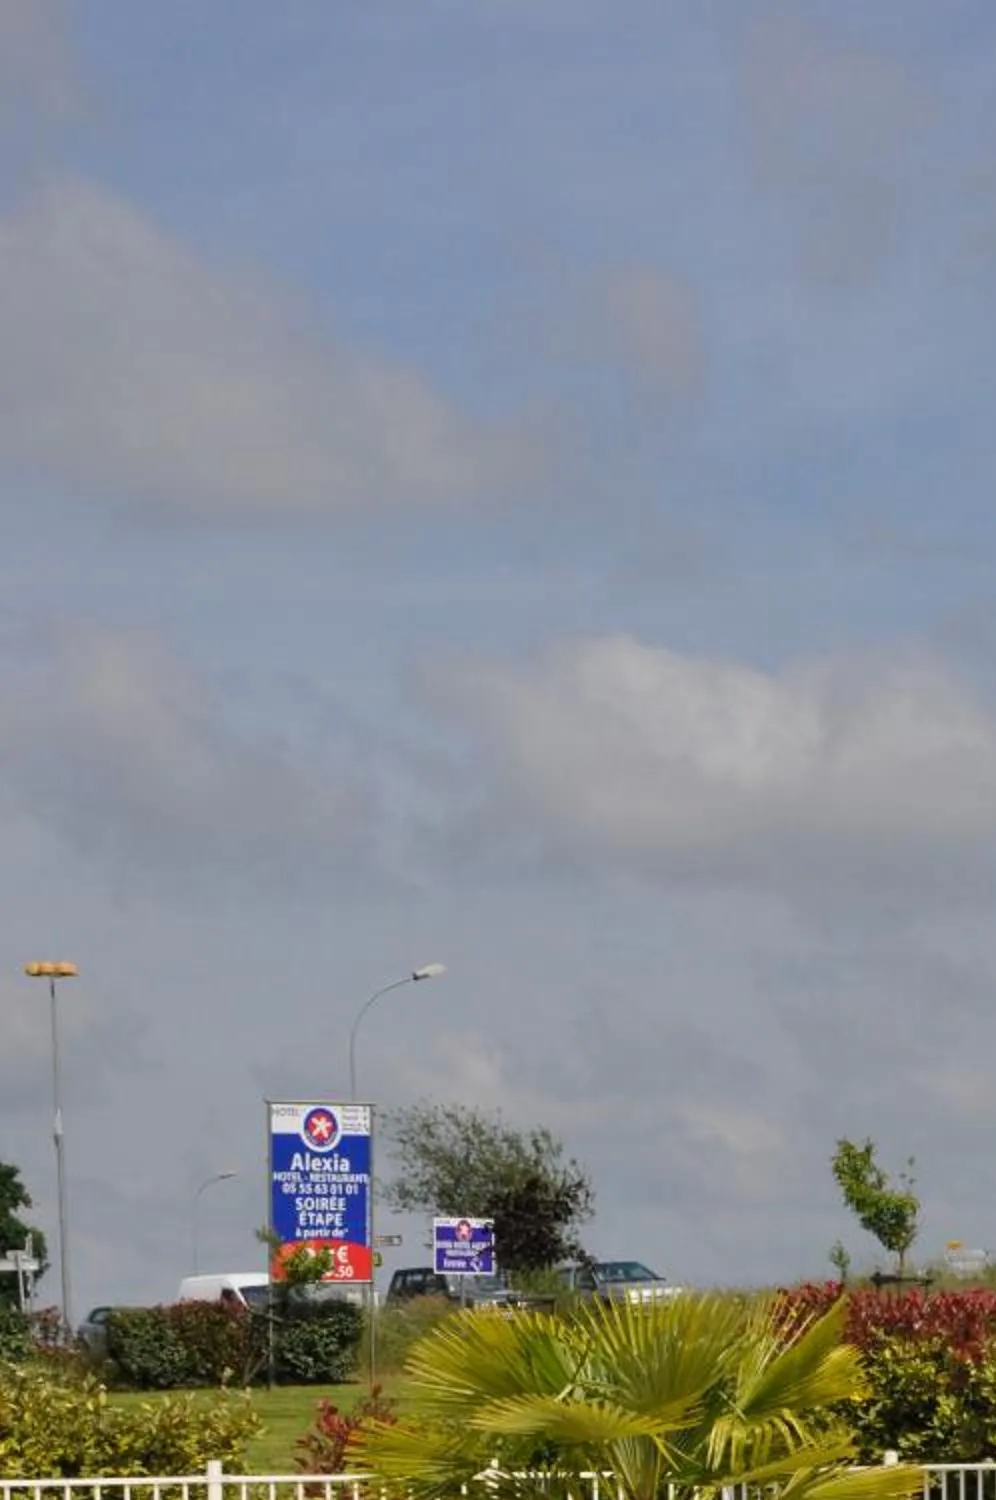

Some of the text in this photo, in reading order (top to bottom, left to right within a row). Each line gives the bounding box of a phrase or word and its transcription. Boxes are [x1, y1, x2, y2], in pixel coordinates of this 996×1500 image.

[290, 1152, 351, 1172] Alexia
[273, 1172, 302, 1182] HOTEL
[295, 1196, 347, 1211] SOIRÉE
[299, 1210, 344, 1227] ÉTAPE
[303, 1227, 331, 1239] partir
